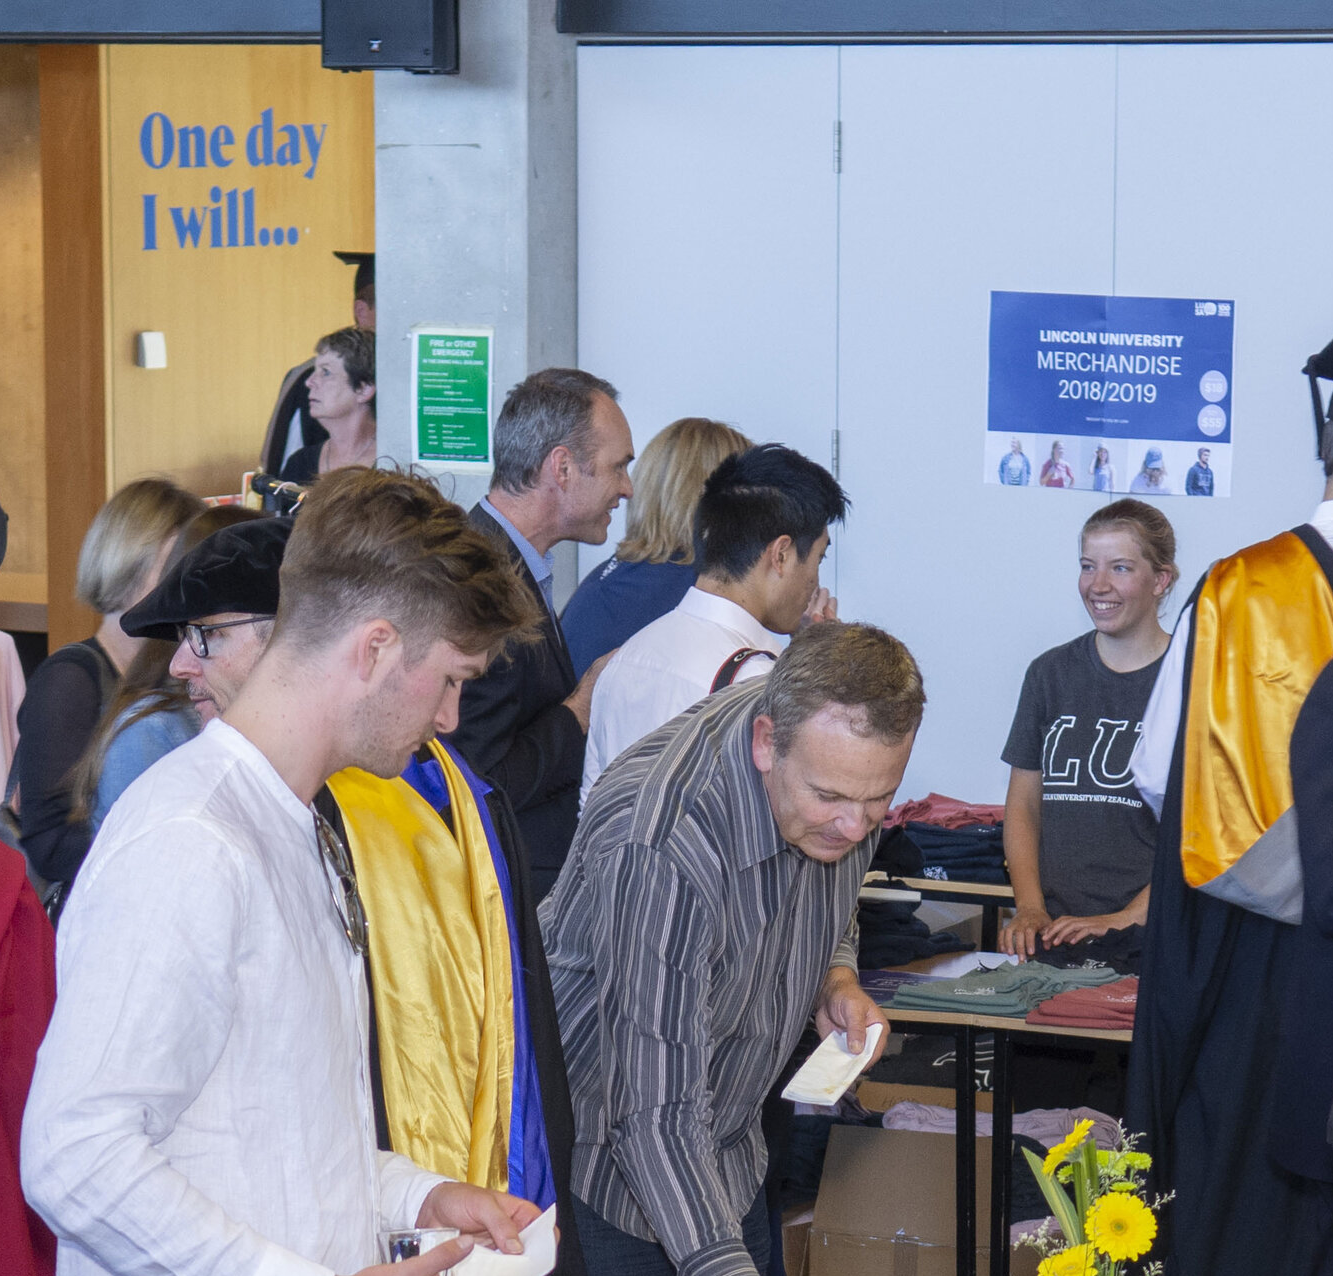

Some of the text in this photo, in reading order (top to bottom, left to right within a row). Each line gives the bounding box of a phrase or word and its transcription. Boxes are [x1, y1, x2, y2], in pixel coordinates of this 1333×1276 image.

[139, 107, 327, 180] One day
[142, 185, 300, 251] I will...
[1040, 330, 1184, 348] LINCOLN UNIVERSITY
[1037, 350, 1182, 376] MERCHANDISE
[1058, 379, 1157, 403] 2018/2019
[1042, 715, 1144, 789] LU
[1054, 793, 1093, 803] UNIVERSITY
[1107, 796, 1143, 808] ZEALAND
